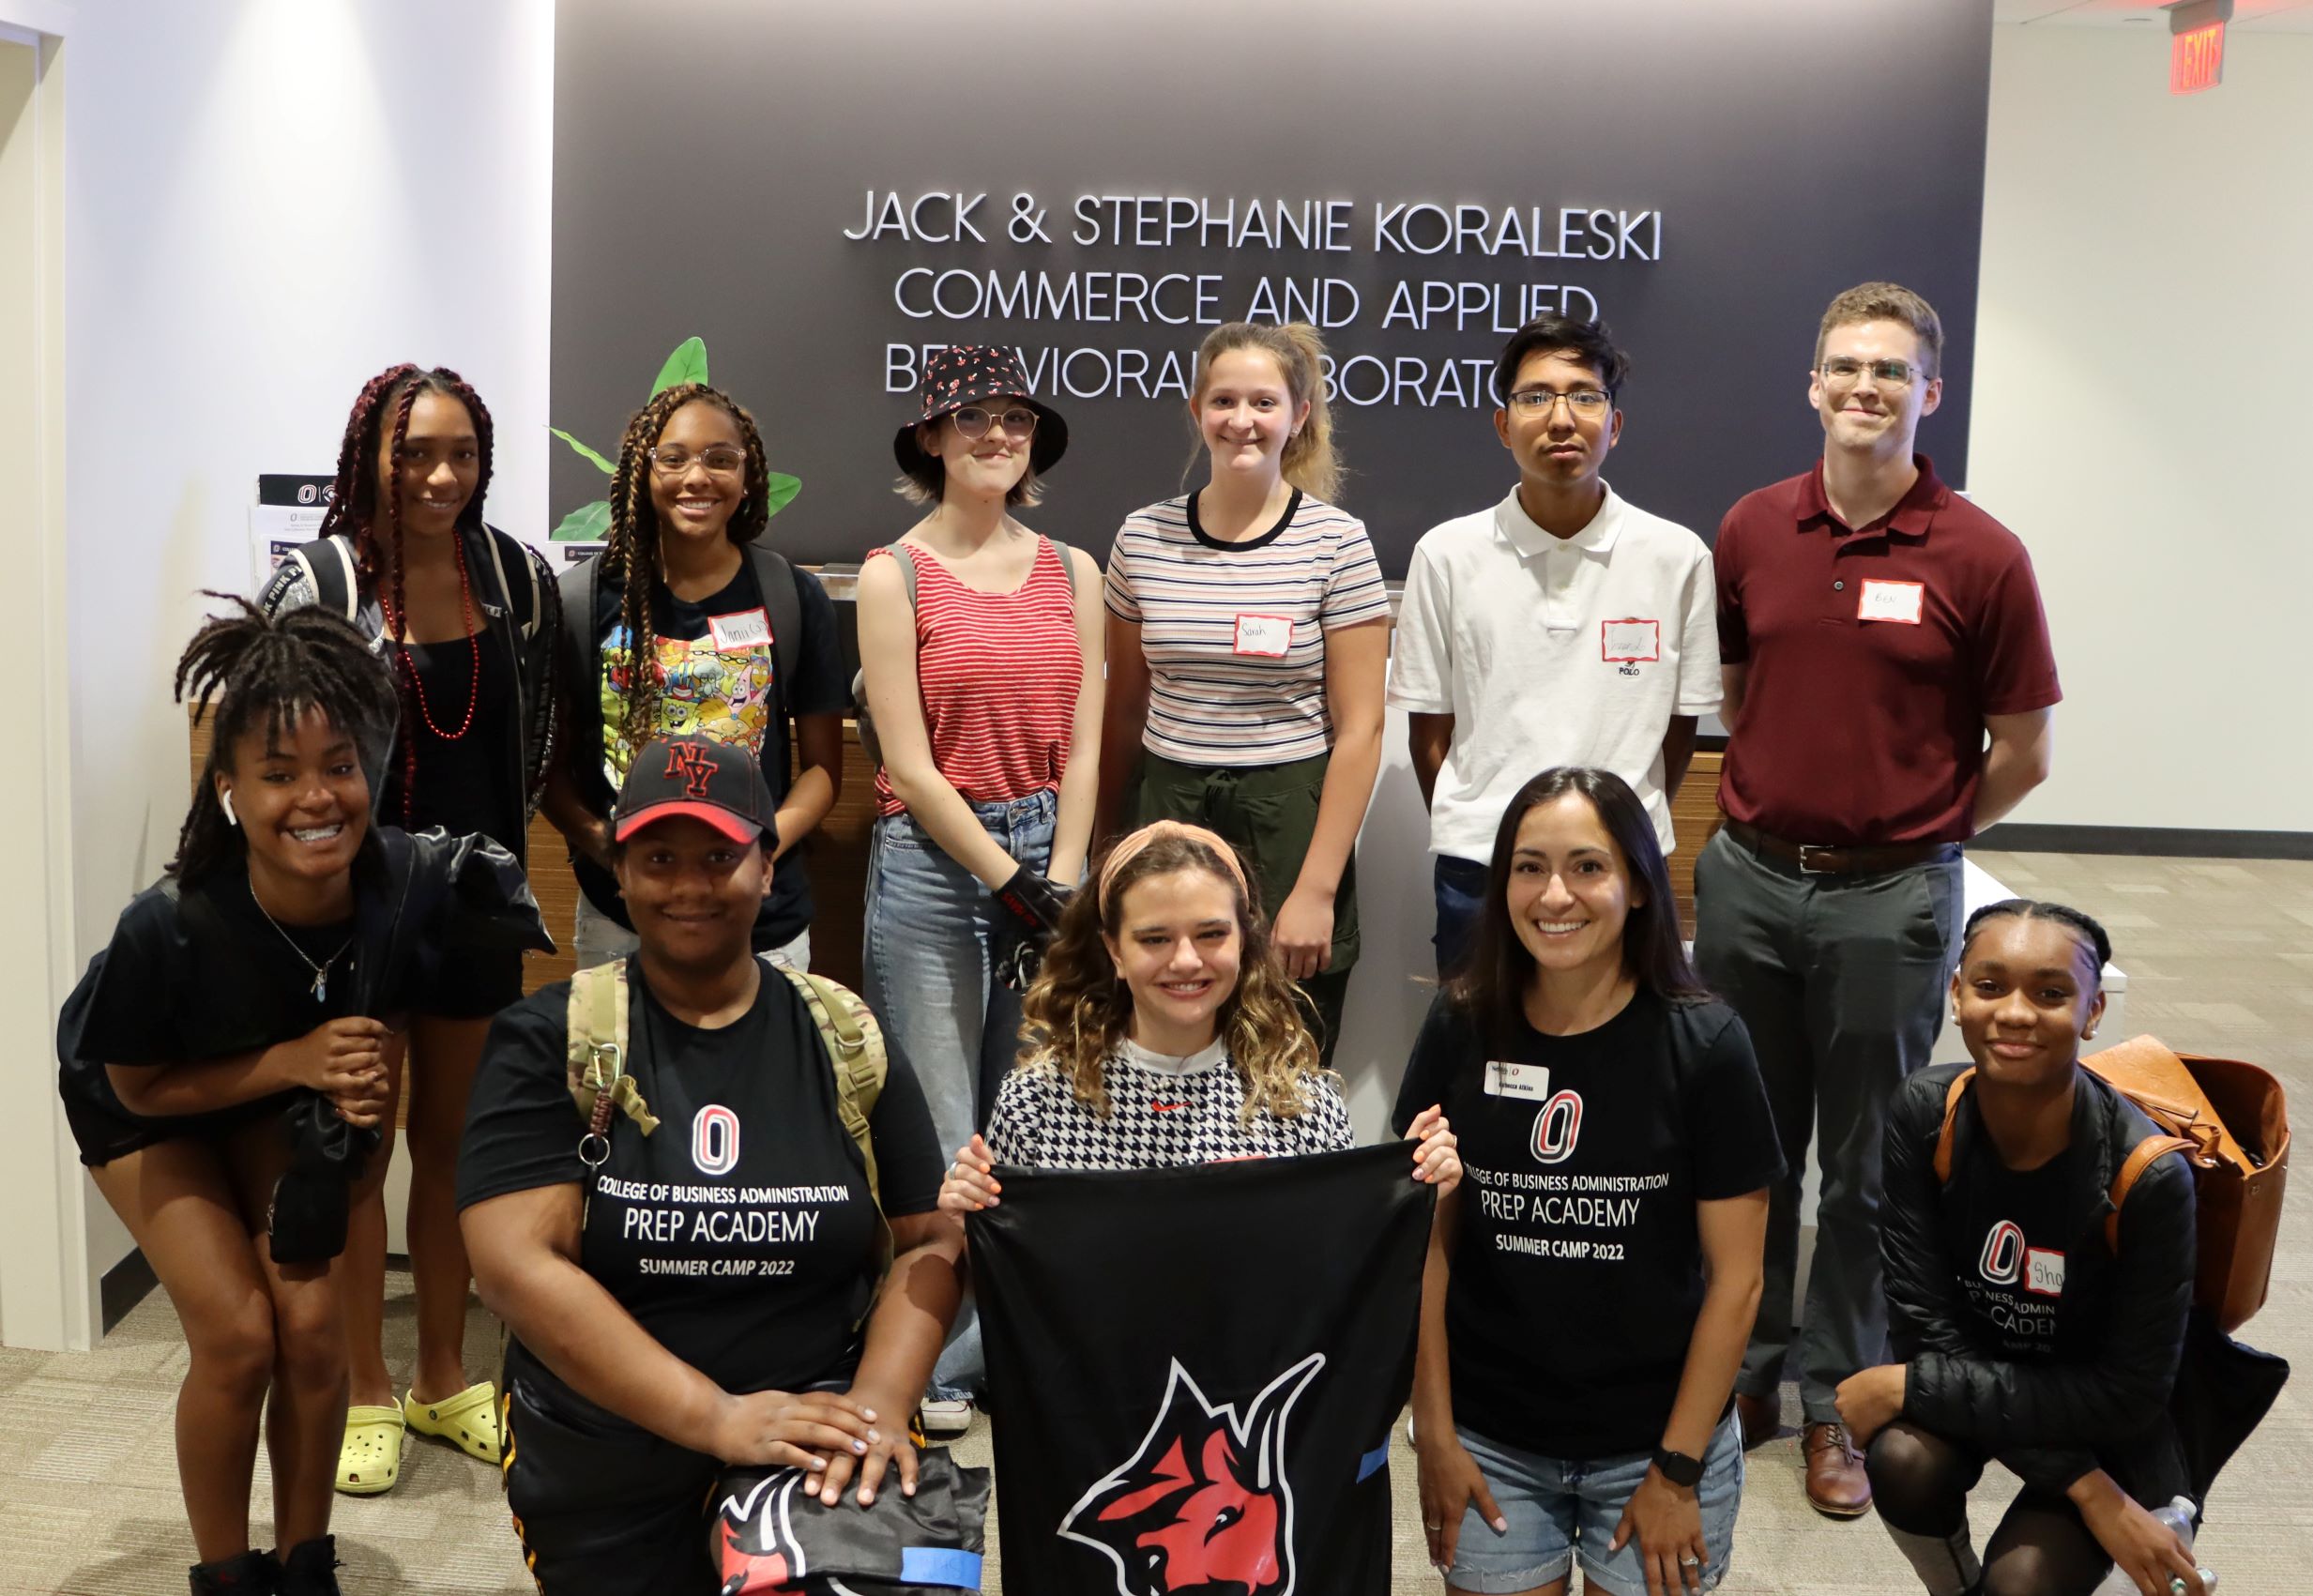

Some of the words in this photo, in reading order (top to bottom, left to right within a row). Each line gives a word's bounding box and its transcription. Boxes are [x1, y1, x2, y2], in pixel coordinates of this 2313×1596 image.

[2183, 29, 2217, 90] EXIT
[843, 190, 987, 243] JACK
[1008, 190, 1053, 243] &
[1073, 193, 1354, 251] STEPHANIE
[1375, 202, 1662, 261] KORALESKI
[894, 267, 1223, 325] COMMERCE
[1244, 276, 1360, 328] AND
[1381, 281, 1599, 333] APPLIED
[267, 574, 292, 601] PINK
[1241, 622, 1267, 636] Sarah
[1619, 666, 1640, 676] POLO
[664, 740, 720, 796] NY
[597, 1175, 648, 1201] COLLEGE
[649, 1183, 670, 1202] OF
[672, 1185, 738, 1205] BUSINESS
[738, 1185, 850, 1204] ADMINISTRATION
[1494, 1171, 1511, 1187] OF
[1512, 1174, 1569, 1191] BUSINESS
[1571, 1173, 1669, 1193] ADMINISTRATION
[1481, 1189, 1526, 1221] PREP
[1530, 1196, 1640, 1227] ACADEMY
[623, 1207, 685, 1242] PREP
[690, 1210, 820, 1242] ACADEMY
[1495, 1233, 1550, 1256] SUMMER
[1551, 1239, 1590, 1258] CAMP
[1592, 1243, 1625, 1260] 2022
[639, 1258, 708, 1276] SUMMER
[711, 1259, 756, 1276] CAMP
[758, 1260, 796, 1276] 2022
